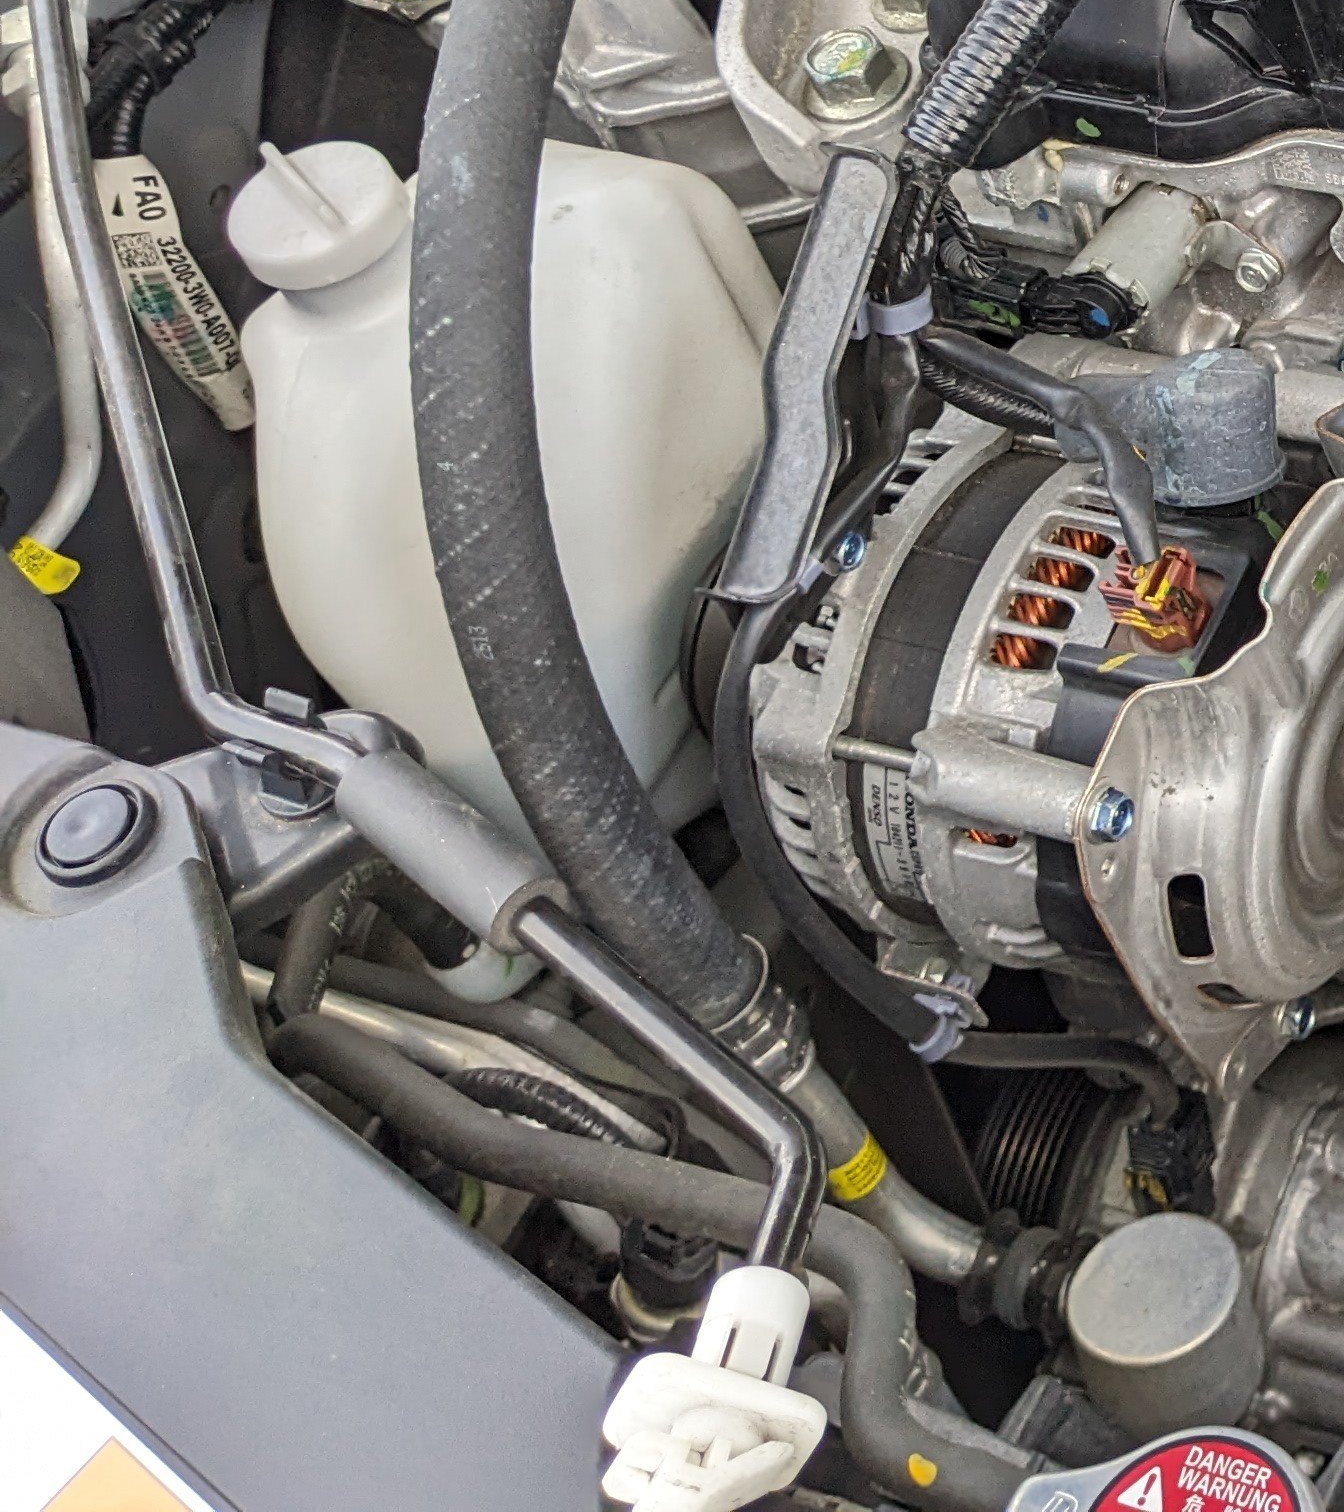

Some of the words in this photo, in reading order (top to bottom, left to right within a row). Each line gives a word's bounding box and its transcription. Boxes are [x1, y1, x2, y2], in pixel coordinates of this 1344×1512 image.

[871, 783, 883, 827] DENSO
[1177, 1466, 1282, 1512] WARNUNG
[1185, 1445, 1272, 1489] DANGER
